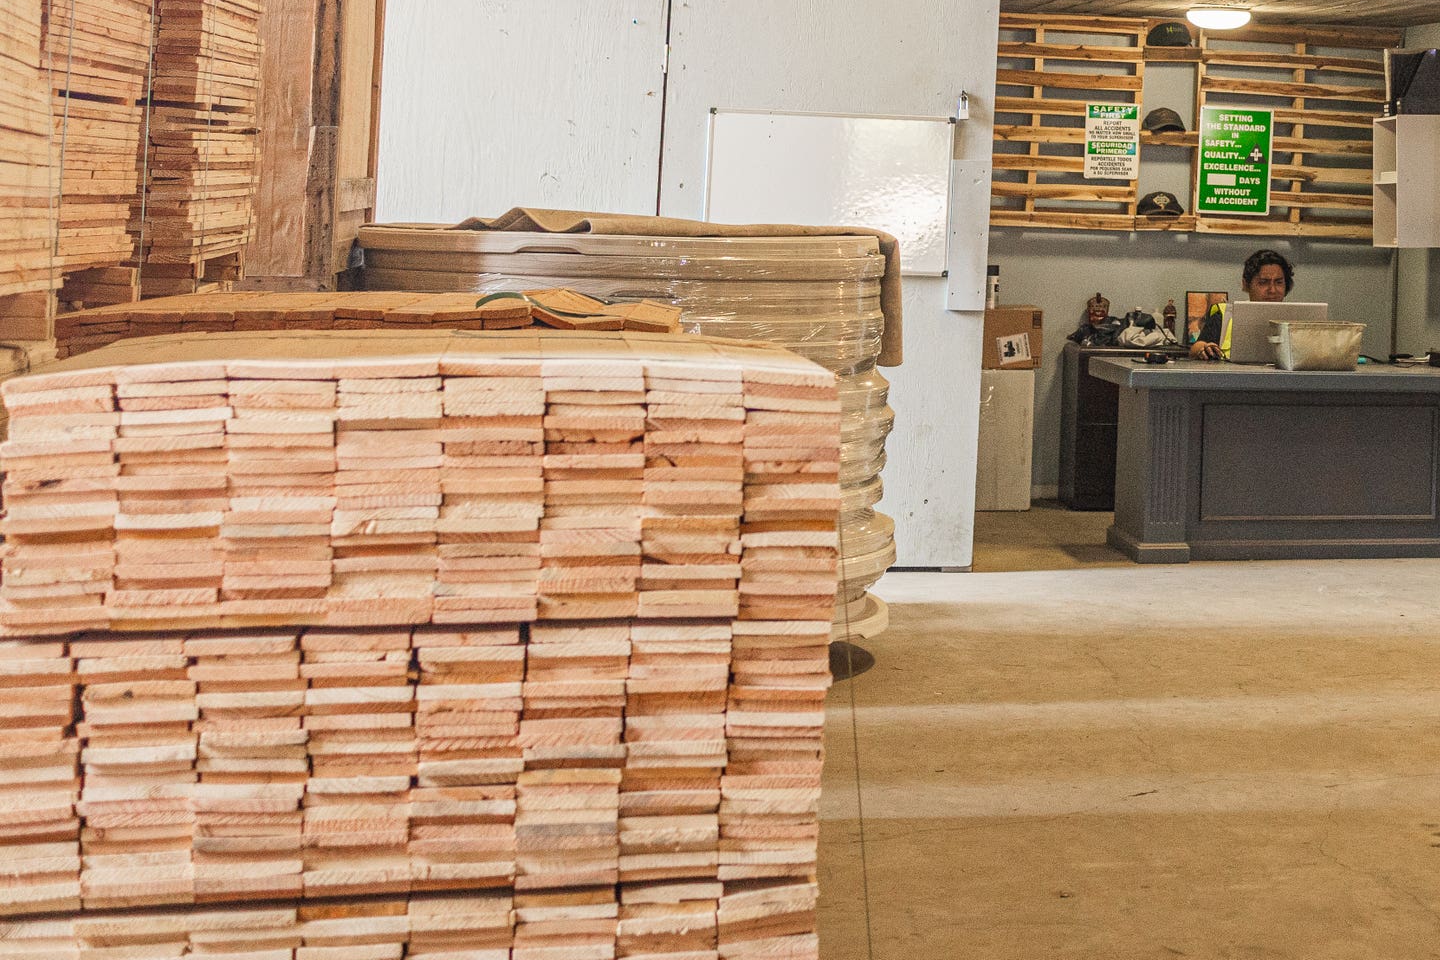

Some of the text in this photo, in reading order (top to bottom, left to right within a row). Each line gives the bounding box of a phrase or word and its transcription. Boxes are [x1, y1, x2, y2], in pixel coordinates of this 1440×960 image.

[1093, 105, 1134, 115] SAFETY
[1218, 114, 1253, 122] SETTING
[1205, 122, 1266, 132] THE STANDARD
[1091, 142, 1133, 150] SEGURIDAD
[1205, 139, 1242, 148] SAFETY...
[1204, 151, 1246, 160] QUALITY...
[1203, 162, 1261, 172] EXCELLENCE...
[1239, 177, 1261, 185] DAYS
[1214, 188, 1251, 196] WITHOUT
[1218, 197, 1258, 205] ACCIDENT
